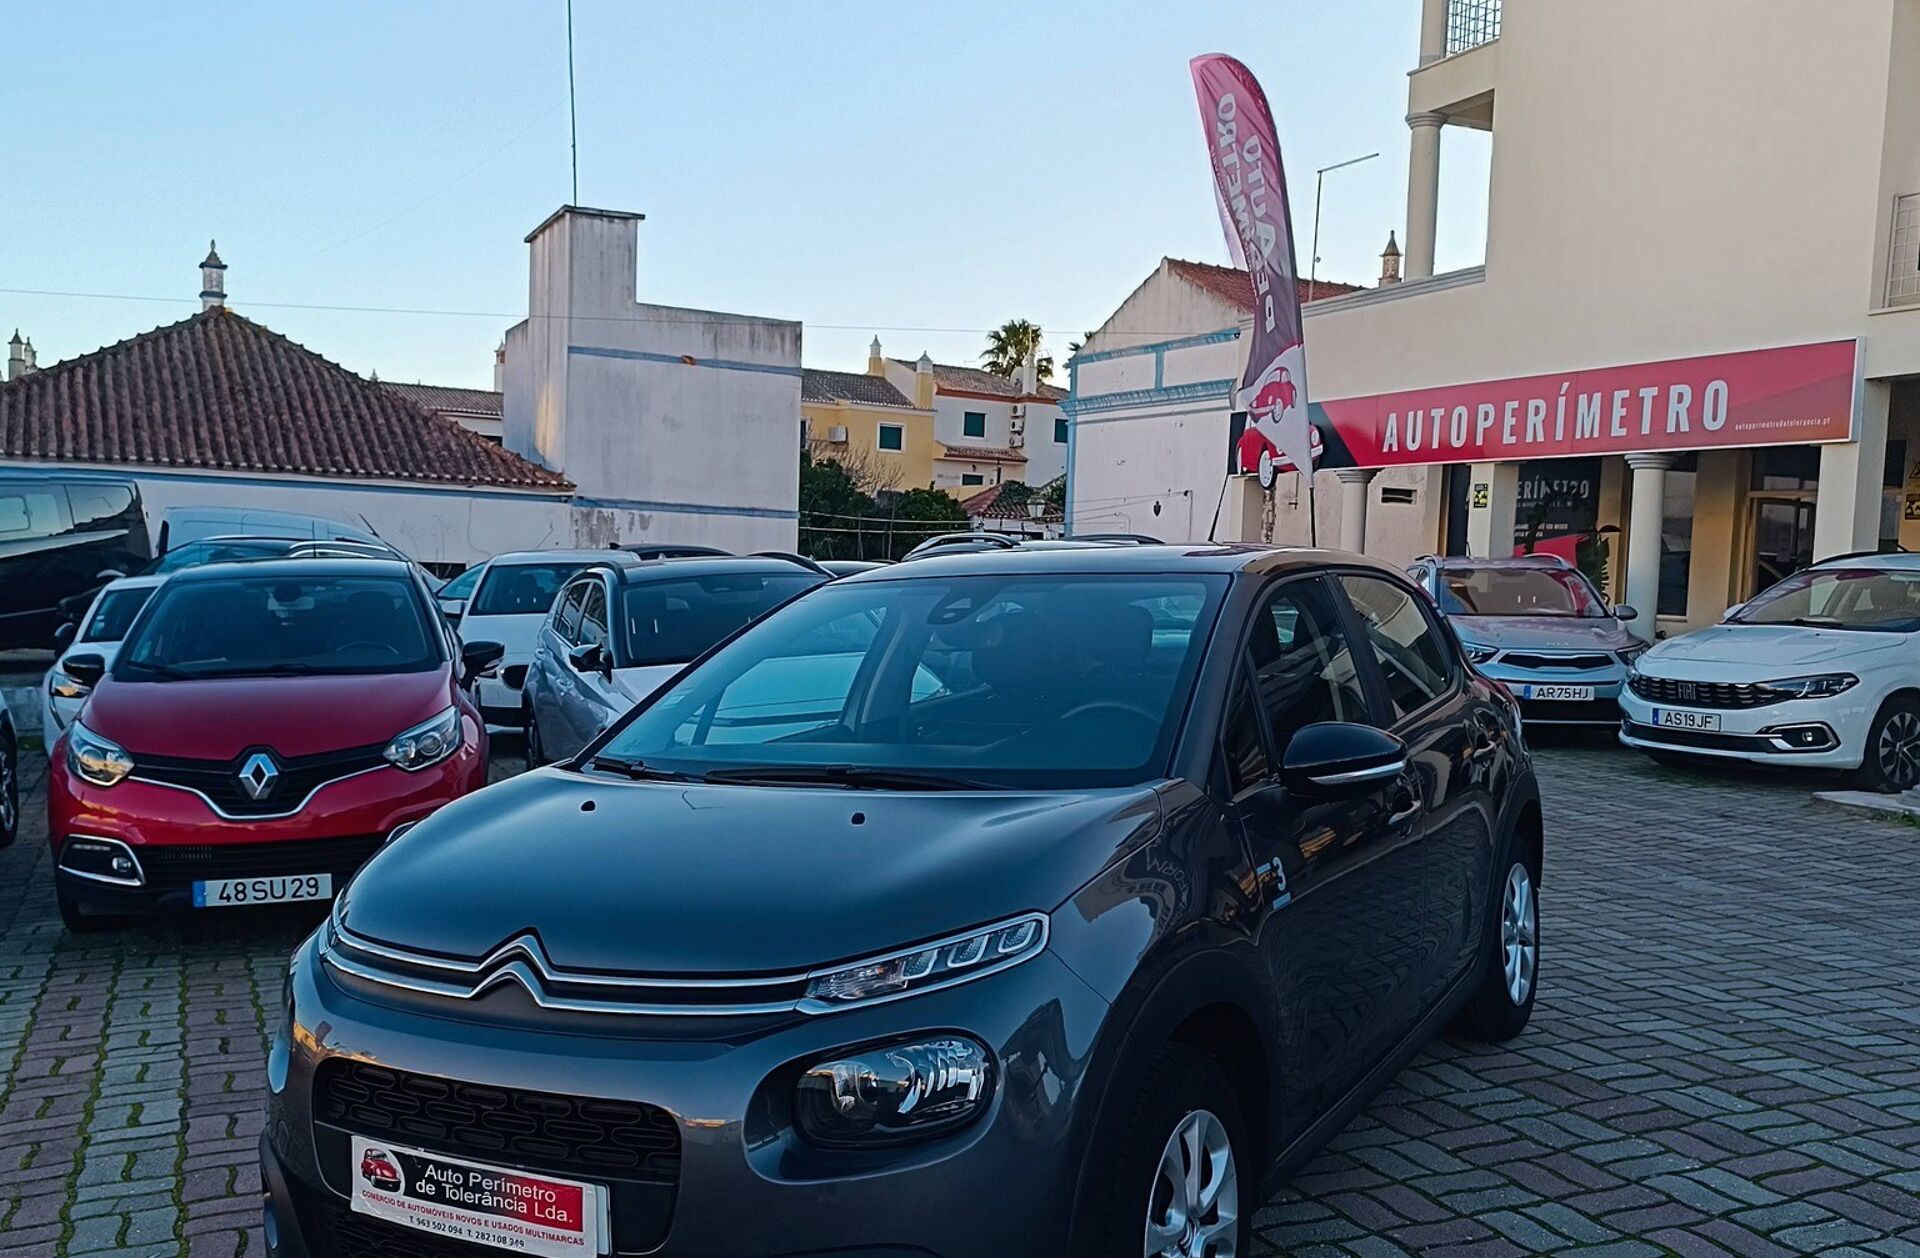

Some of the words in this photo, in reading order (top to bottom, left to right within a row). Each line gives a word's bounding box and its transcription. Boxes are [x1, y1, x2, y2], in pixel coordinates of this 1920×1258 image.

[1382, 378, 1729, 453] AUTOPERÍMETRO
[1677, 683, 1697, 700] FIAT
[416, 1179, 436, 1195] de
[442, 1182, 527, 1214] Tolerância
[534, 1201, 573, 1223] Lda.
[424, 1164, 463, 1185] Auto
[469, 1171, 556, 1203] Perímetro
[397, 1200, 406, 1208] DE
[456, 1214, 482, 1227] NOVOS
[484, 1220, 489, 1228] E
[491, 1221, 523, 1234] USADOS
[525, 1228, 585, 1246] MULTIMARCAS
[432, 1221, 446, 1232] 502
